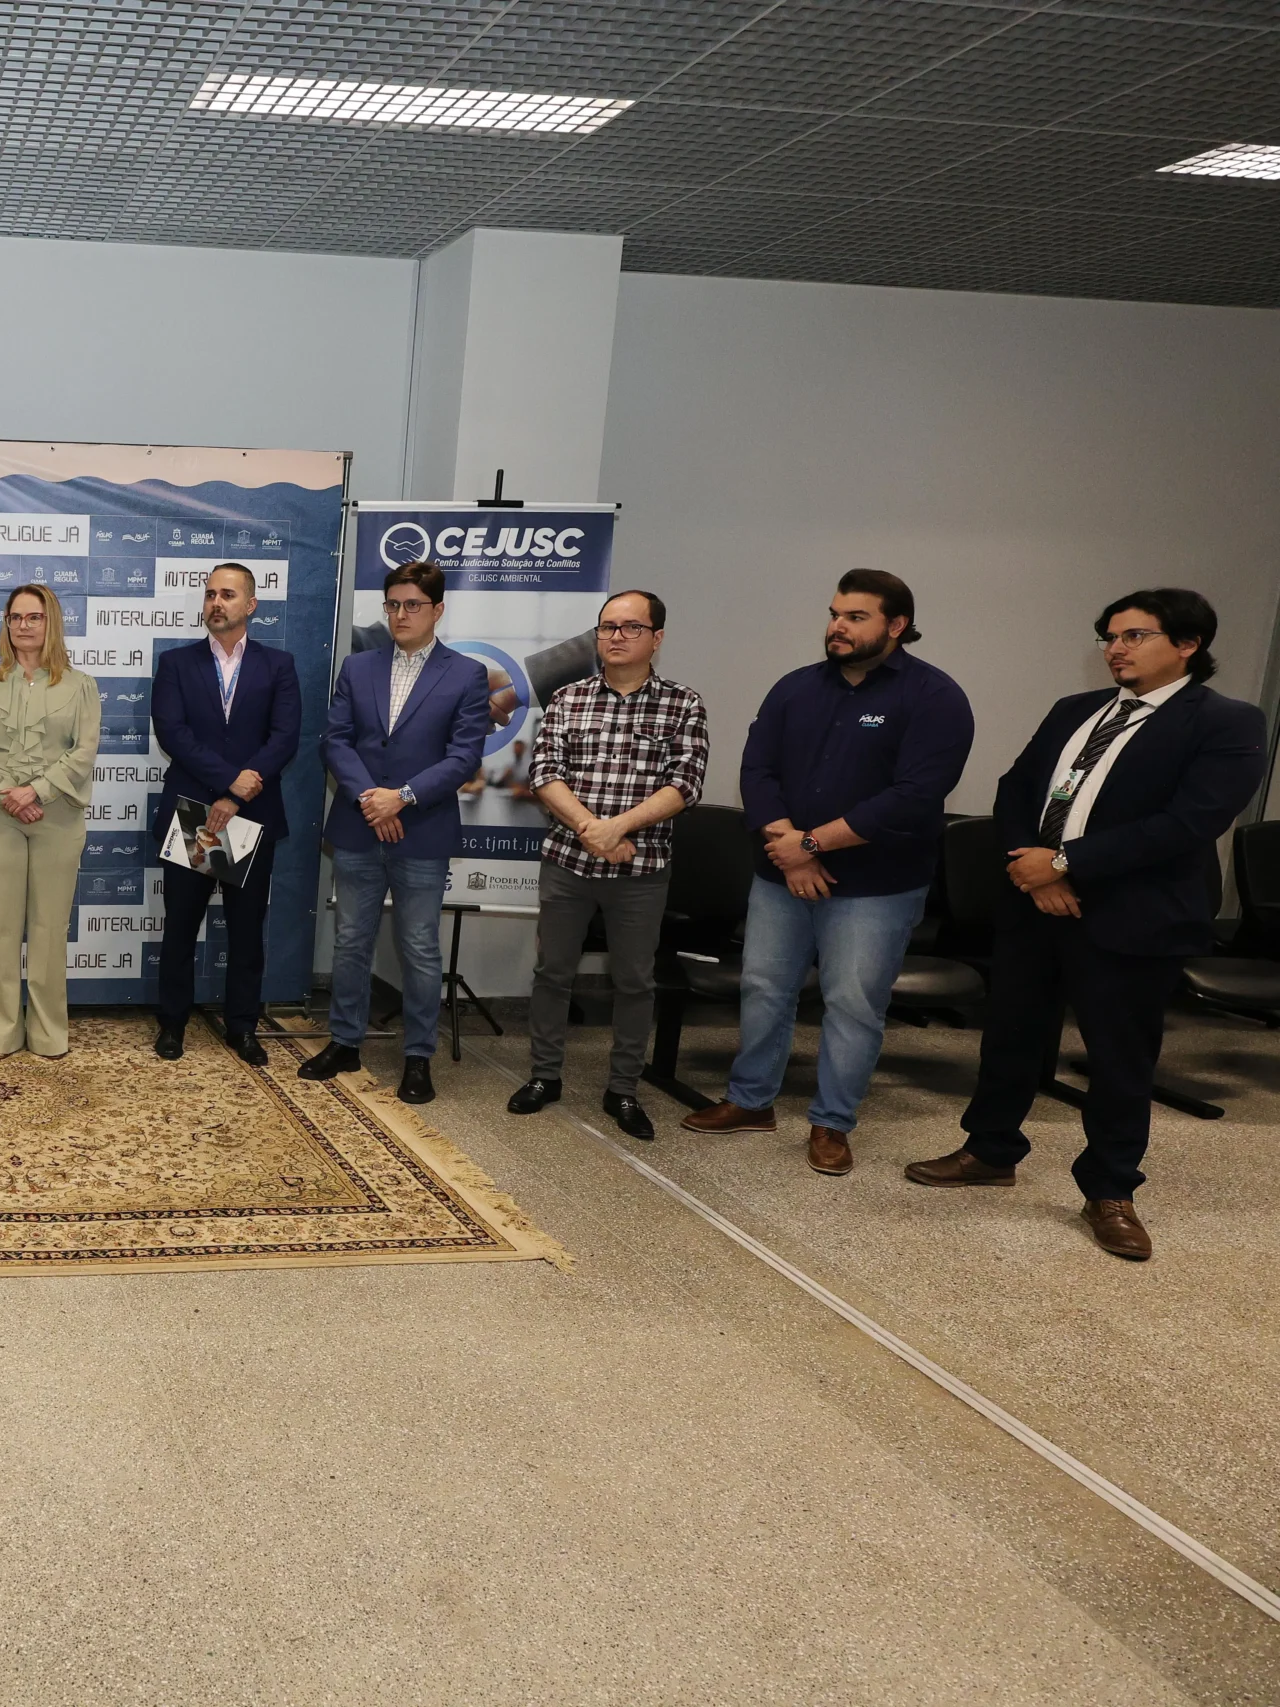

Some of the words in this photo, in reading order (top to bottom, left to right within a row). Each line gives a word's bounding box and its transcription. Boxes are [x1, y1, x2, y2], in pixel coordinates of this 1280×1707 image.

[435, 526, 585, 557] CEJUSC
[435, 558, 459, 567] Centro
[460, 558, 499, 567] Judiciário
[501, 559, 533, 569] Solução
[534, 559, 545, 568] de
[468, 573, 498, 582] CEJUSC
[500, 574, 542, 583] AMBIENTAL
[489, 876, 518, 885] PODER
